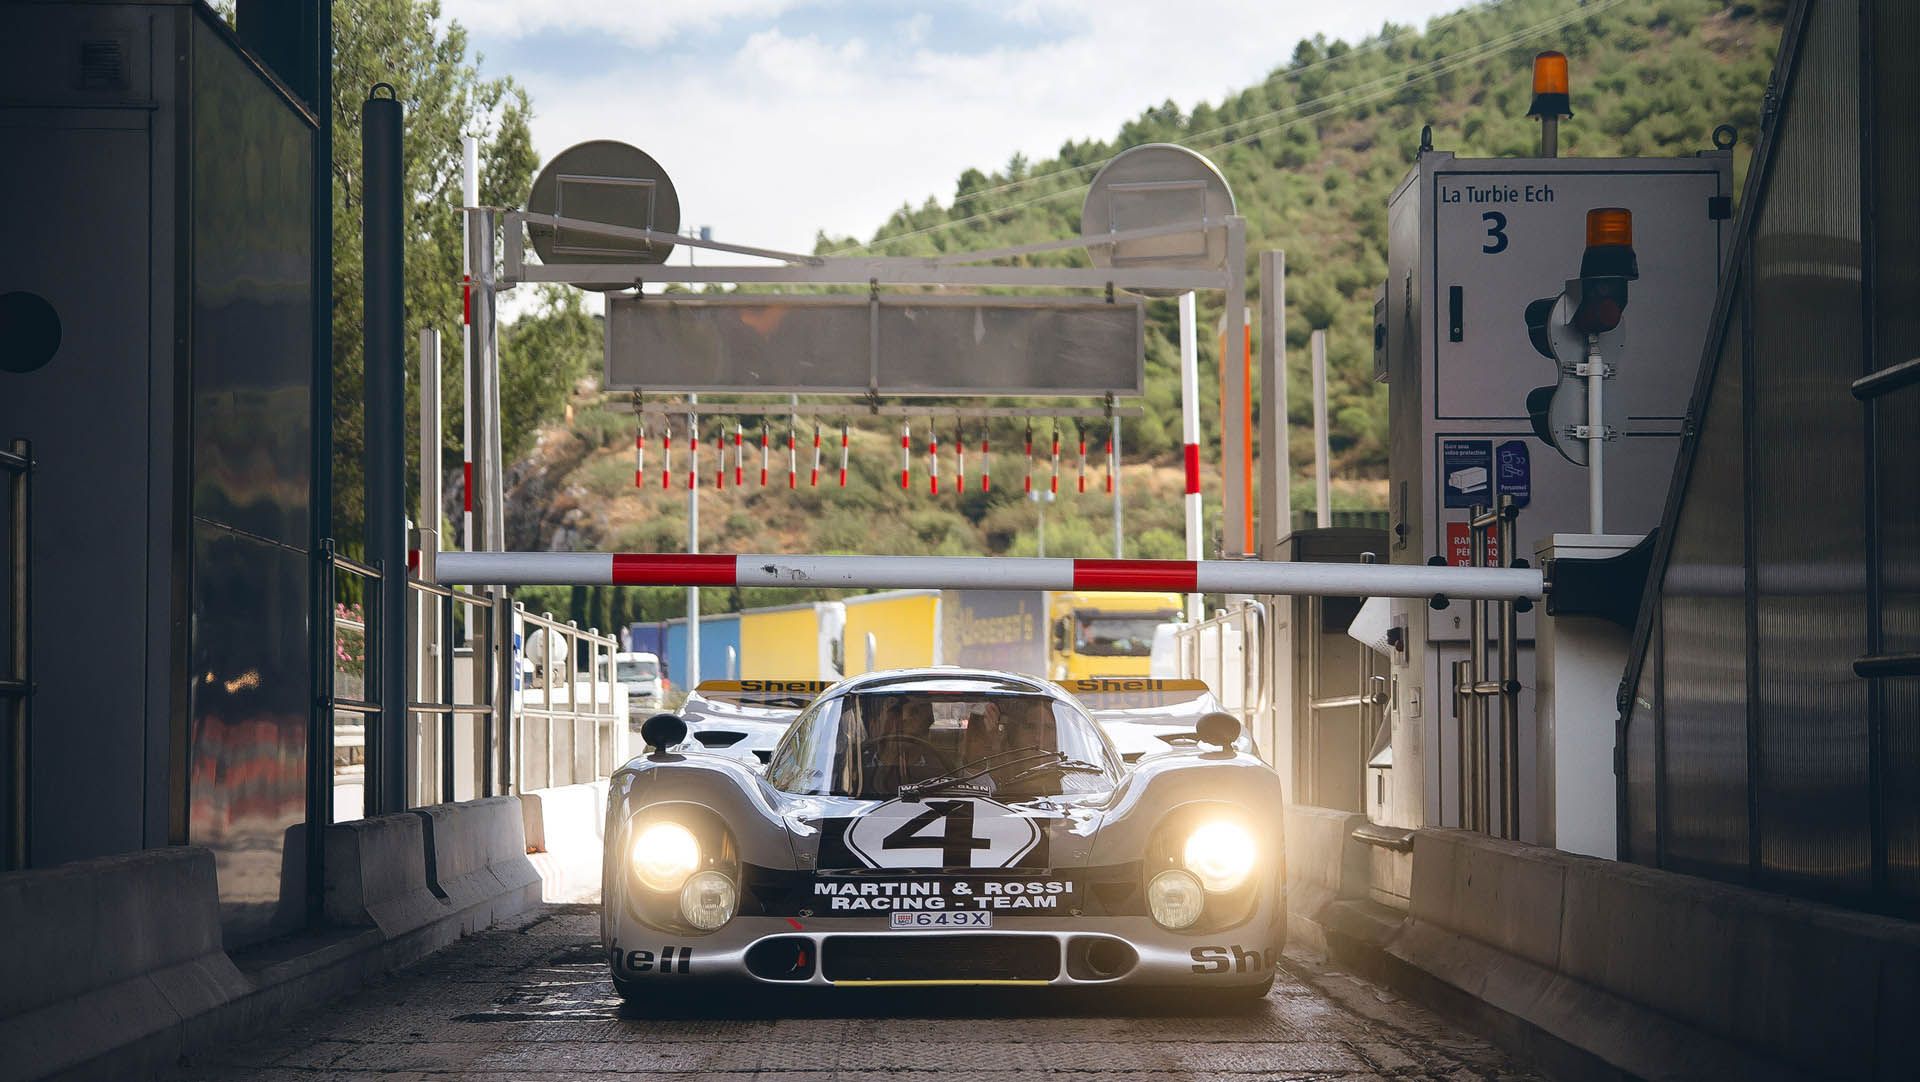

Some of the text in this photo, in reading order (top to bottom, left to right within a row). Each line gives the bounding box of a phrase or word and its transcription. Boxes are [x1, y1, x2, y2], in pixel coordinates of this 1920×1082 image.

[1442, 184, 1554, 203] La Turbie Ech
[1482, 211, 1509, 254] 3
[740, 680, 827, 692] Shell
[1077, 679, 1163, 691] Shell
[882, 801, 991, 868] 4
[814, 881, 1072, 896] MARTINI & ROSSI
[831, 897, 946, 910] RACING
[973, 896, 1057, 908] TEAM
[916, 912, 986, 926] 649X
